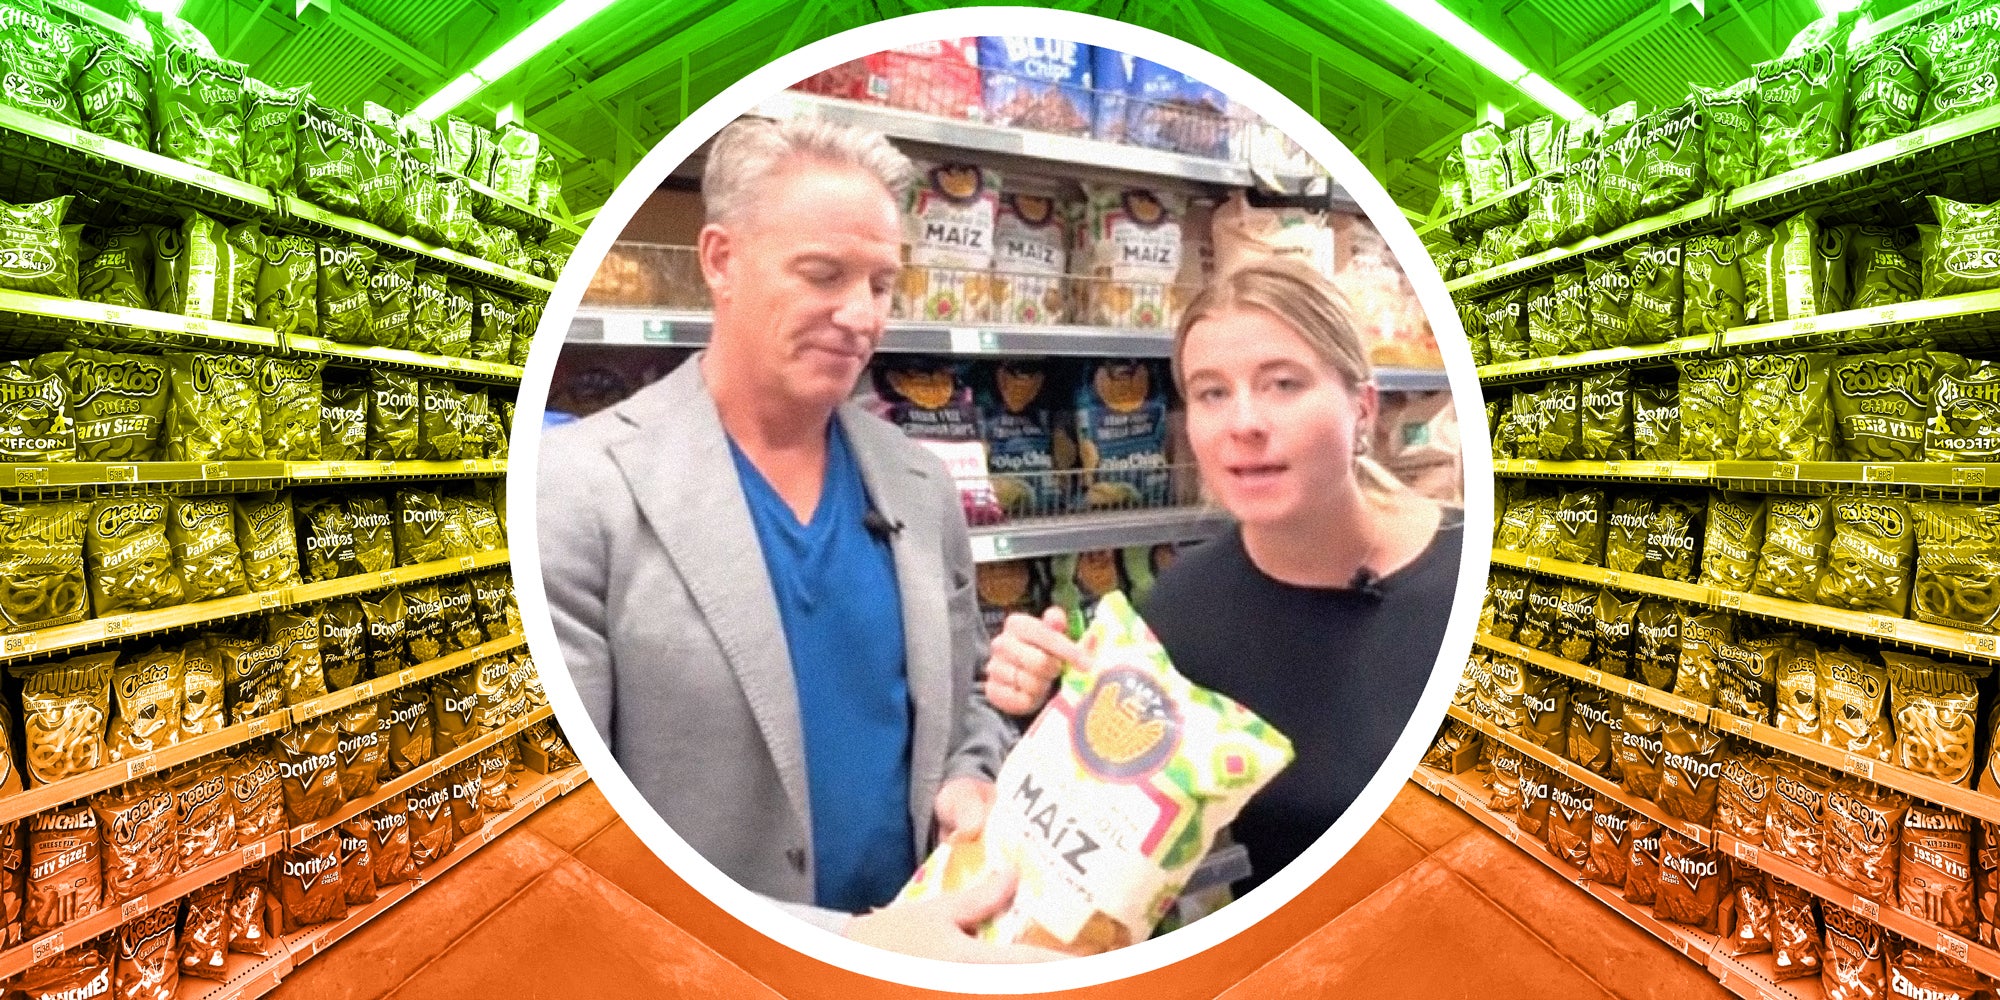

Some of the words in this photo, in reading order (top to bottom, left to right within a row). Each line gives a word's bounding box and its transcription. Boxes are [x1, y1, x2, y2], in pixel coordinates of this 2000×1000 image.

[353, 125, 399, 158] oritos
[364, 270, 413, 292] oritos
[69, 360, 159, 403] Cheetos
[92, 399, 140, 415] Puffs
[377, 391, 418, 408] Dorito
[322, 407, 365, 421] oritos
[77, 421, 112, 439] arty
[114, 418, 149, 433] Size!
[0, 438, 67, 450] UFFCORN
[99, 503, 161, 535] Cheetos
[182, 500, 230, 528] Cheetos
[249, 502, 285, 527] heetos
[403, 509, 445, 523] Dorito
[187, 537, 215, 557] Party
[253, 544, 278, 560] Party
[306, 533, 353, 551] Doritos
[103, 544, 135, 568] Party
[238, 646, 281, 675] Cheetos
[122, 664, 169, 698] Cheetos
[337, 732, 378, 754] oritos
[279, 750, 337, 779] Doritos
[235, 759, 280, 802] Cheetos
[31, 807, 97, 831] UNCHIES
[114, 792, 172, 845] Cheetos
[372, 811, 407, 831] oritos
[32, 861, 56, 880] arty
[57, 845, 87, 869] Size!
[284, 850, 337, 877] Doritos
